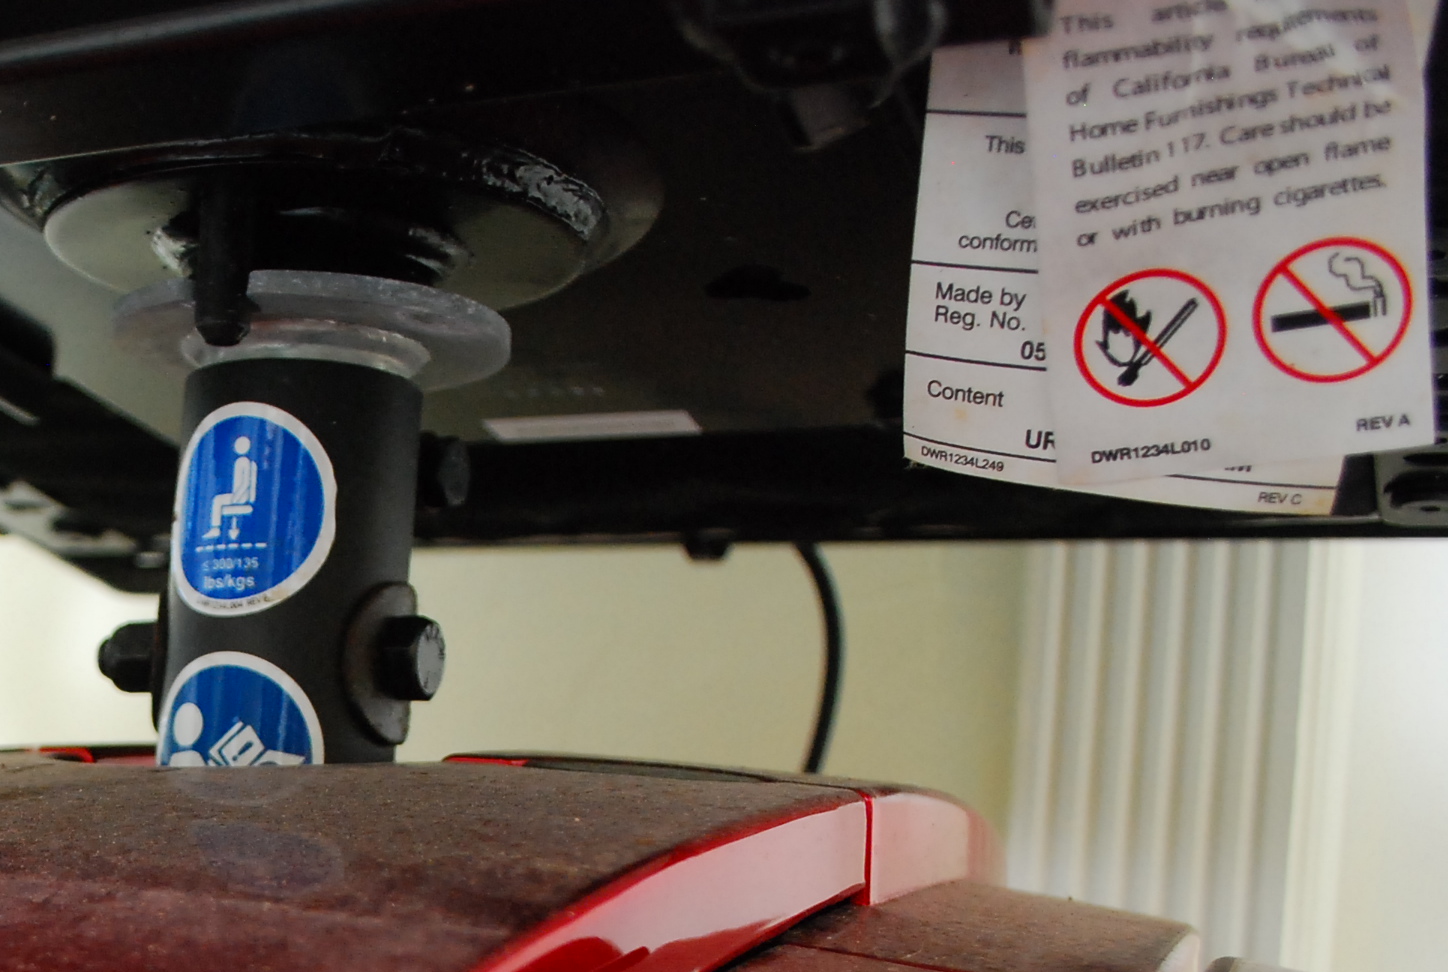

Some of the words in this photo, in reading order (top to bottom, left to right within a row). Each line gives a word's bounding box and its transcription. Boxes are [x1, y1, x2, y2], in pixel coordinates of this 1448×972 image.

[1060, 15, 1114, 34] This
[1062, 35, 1214, 69] flammability
[1066, 82, 1091, 105] of
[1113, 66, 1232, 98] California
[1070, 118, 1139, 142] Home
[1144, 89, 1278, 131] Furnishings
[985, 135, 1026, 155] This
[1072, 150, 1161, 178] Bulletin
[1220, 123, 1275, 145] Care
[1280, 103, 1357, 134] should
[1364, 100, 1392, 118] be
[1075, 175, 1179, 213] exercised
[1191, 165, 1240, 187] near
[1254, 152, 1311, 176] open
[1324, 137, 1392, 161] flame
[1077, 231, 1098, 247] or
[1112, 215, 1161, 240] with
[1173, 196, 1261, 225] burning
[935, 282, 993, 305] Made
[1000, 287, 1026, 311] by
[934, 304, 981, 331] Reg.
[990, 310, 1026, 331] No.
[1020, 341, 1046, 361] 05
[927, 380, 1004, 407] Content
[1356, 415, 1393, 432] REV
[1398, 413, 1411, 427] A
[920, 445, 1005, 472] DWR1234L249
[1091, 438, 1212, 464] DWR1234L010
[1258, 491, 1287, 504] REV
[1291, 493, 1302, 505] C
